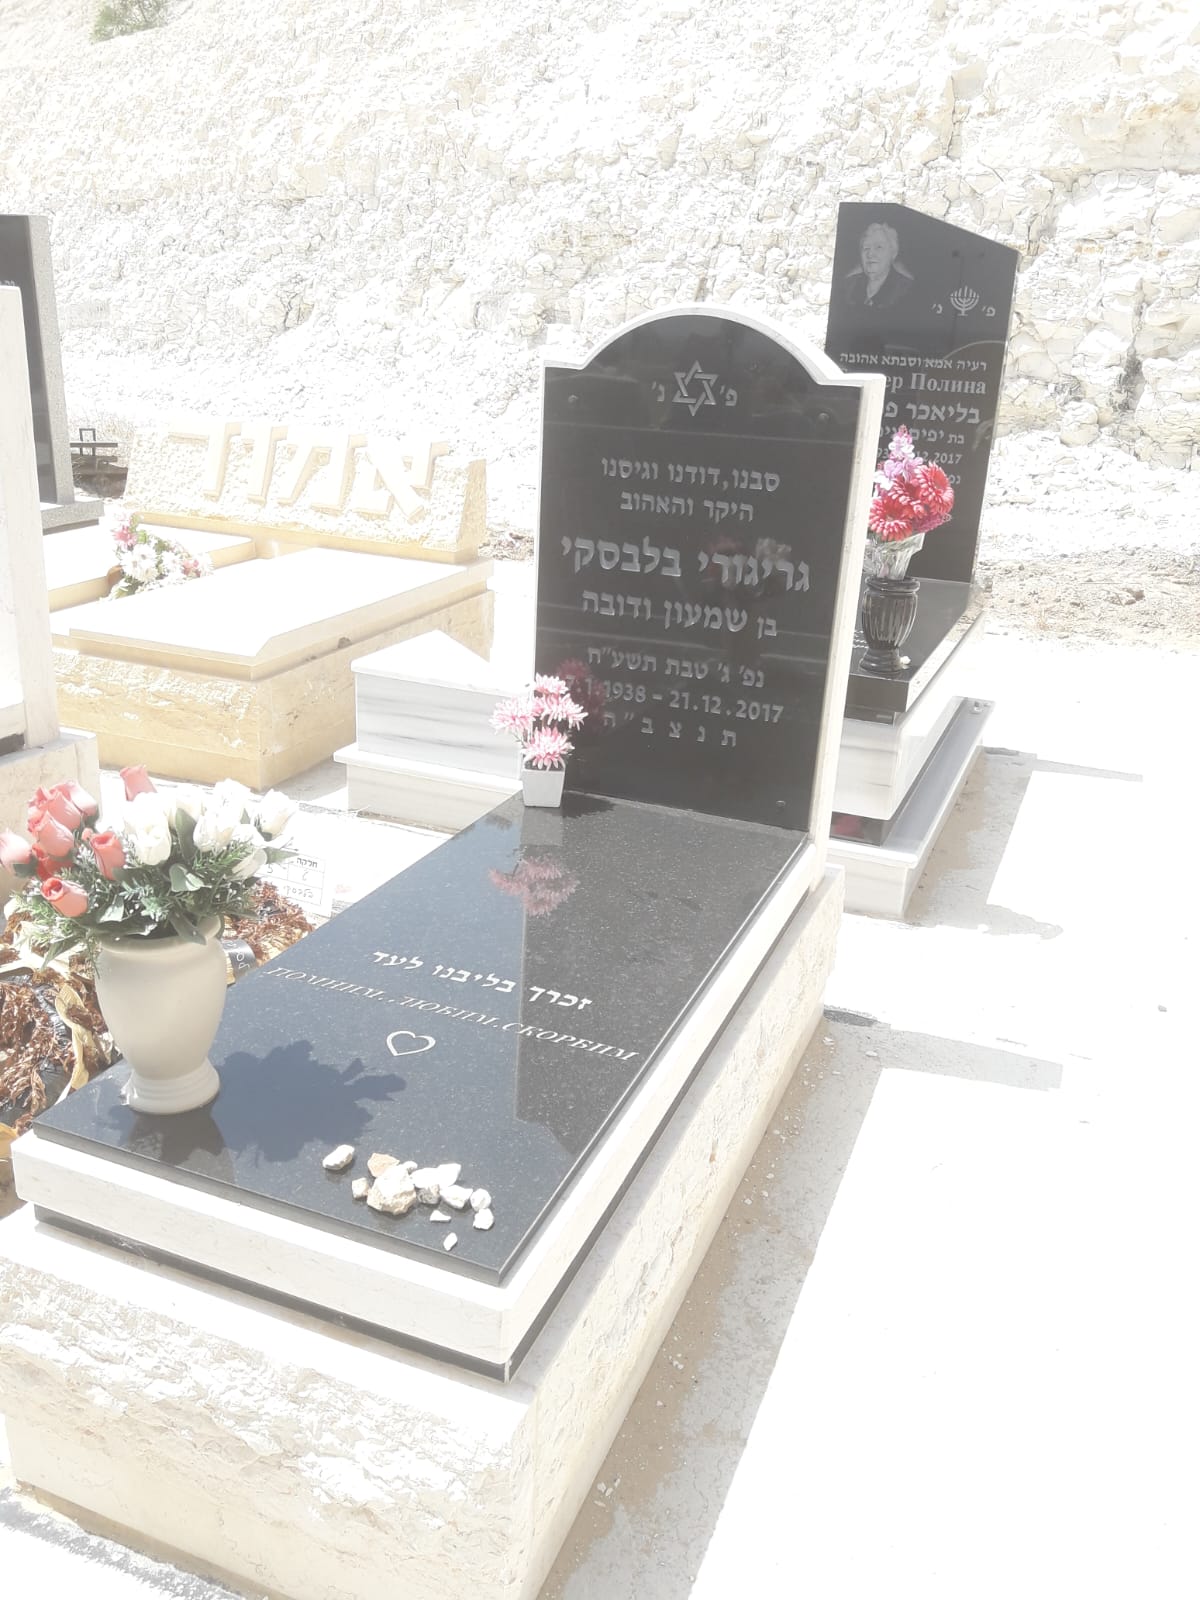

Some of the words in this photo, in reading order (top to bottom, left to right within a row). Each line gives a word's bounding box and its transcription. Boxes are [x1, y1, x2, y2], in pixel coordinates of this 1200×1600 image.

[839, 352, 879, 365] אהובה
[924, 358, 953, 370] אמא
[910, 372, 987, 395] Полина
[905, 401, 981, 425] בליאכר
[947, 432, 965, 445] בת
[601, 457, 658, 480] וגיסנו
[620, 491, 694, 516] והאהוב
[703, 500, 754, 524] היקר
[561, 536, 682, 577] בלבסקי
[697, 551, 810, 593] גריגורי
[582, 590, 651, 620] ודובה
[664, 600, 748, 632] שמעון
[756, 616, 778, 639] בן
[665, 656, 709, 680] טבת
[669, 690, 785, 723] 21.12.2017
[296, 857, 318, 868] חלקה
[373, 951, 424, 970] לעד
[432, 964, 517, 993] בליבנו
[529, 986, 592, 1010] זכרך
